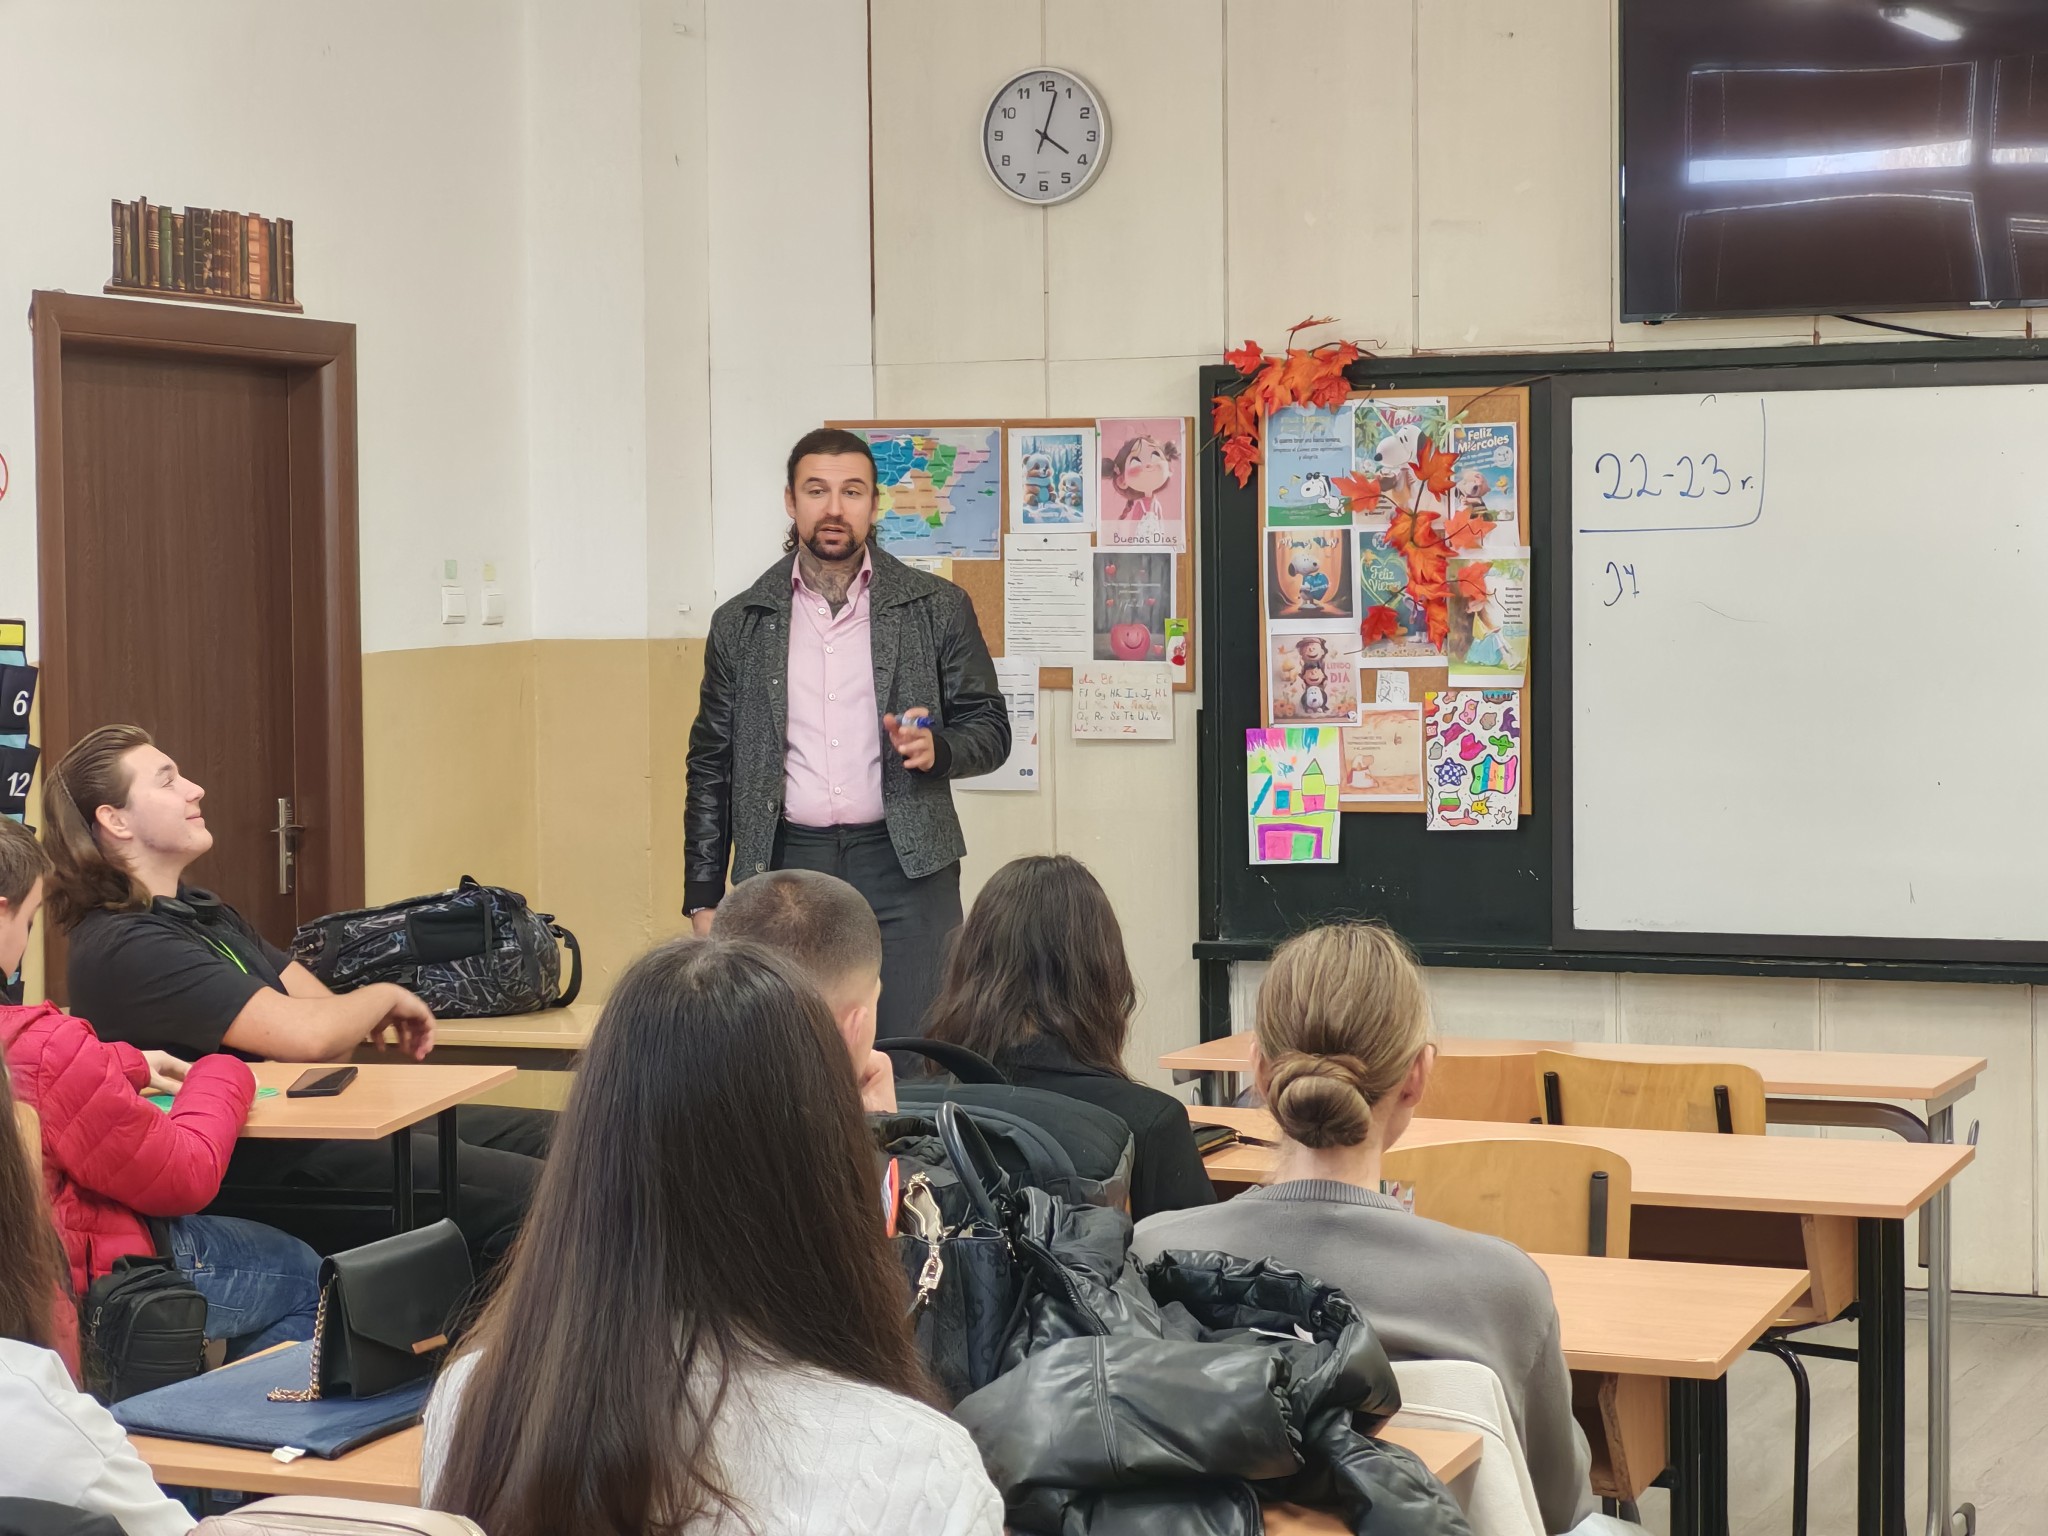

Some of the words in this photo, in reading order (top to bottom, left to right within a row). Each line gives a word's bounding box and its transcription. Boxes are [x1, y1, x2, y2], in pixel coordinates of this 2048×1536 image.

[1039, 80, 1056, 92] 12
[1017, 88, 1030, 99] 11
[1065, 87, 1072, 99] 1
[1001, 107, 1016, 119] 10
[1080, 107, 1090, 119] 2
[994, 130, 1004, 142] 9
[1086, 130, 1096, 142] 3
[1001, 155, 1011, 166] 8
[1077, 153, 1088, 165] 4
[1016, 173, 1026, 184] 7
[1061, 172, 1071, 184] 5
[1039, 180, 1049, 191] 6
[1375, 409, 1423, 429] Martes
[1468, 427, 1493, 441] Feliz
[1595, 452, 1732, 500] 22-23
[1113, 532, 1150, 544] Buenos
[1370, 565, 1395, 580] Feliz
[13, 690, 29, 716] 6
[7, 771, 31, 797] 12
